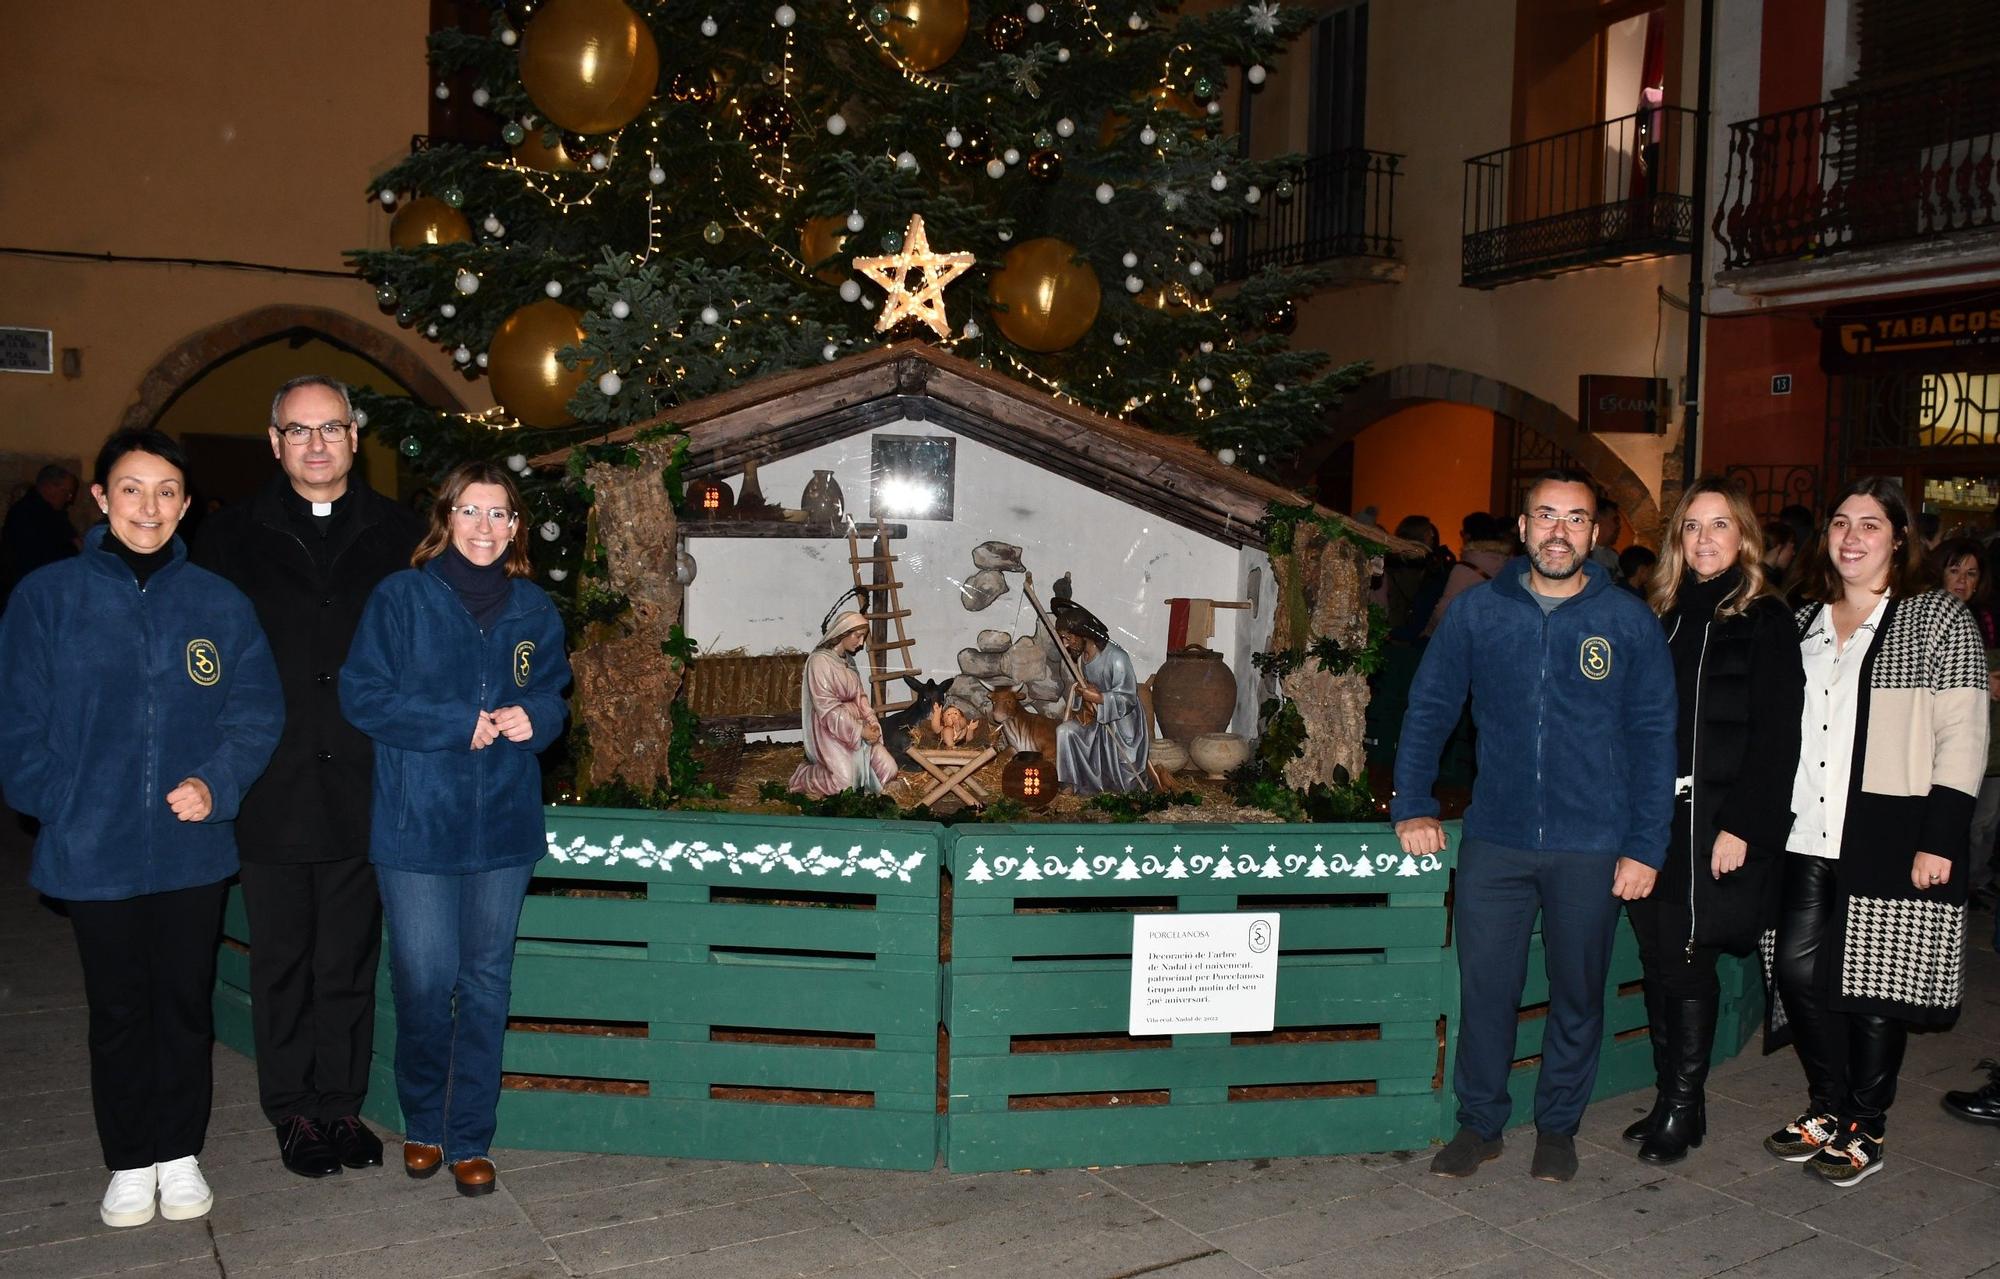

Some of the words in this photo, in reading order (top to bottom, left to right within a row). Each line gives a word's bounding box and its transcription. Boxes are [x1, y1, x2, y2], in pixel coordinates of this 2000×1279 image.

[1877, 309, 2000, 338] TABACOS
[1776, 378, 1787, 390] 13
[1149, 931, 1210, 939] PORCELANOSA
[1148, 952, 1193, 960] Decoració
[1195, 951, 1206, 959] de
[1147, 963, 1159, 971] de
[1161, 963, 1187, 971] Nadal
[1194, 962, 1203, 970] el
[1147, 975, 1193, 984] patrocinat
[1195, 975, 1210, 983] per
[1212, 973, 1265, 981] Porcelanosa
[1147, 986, 1175, 995] Grupo
[1177, 985, 1197, 993] amb
[1226, 983, 1240, 991] del
